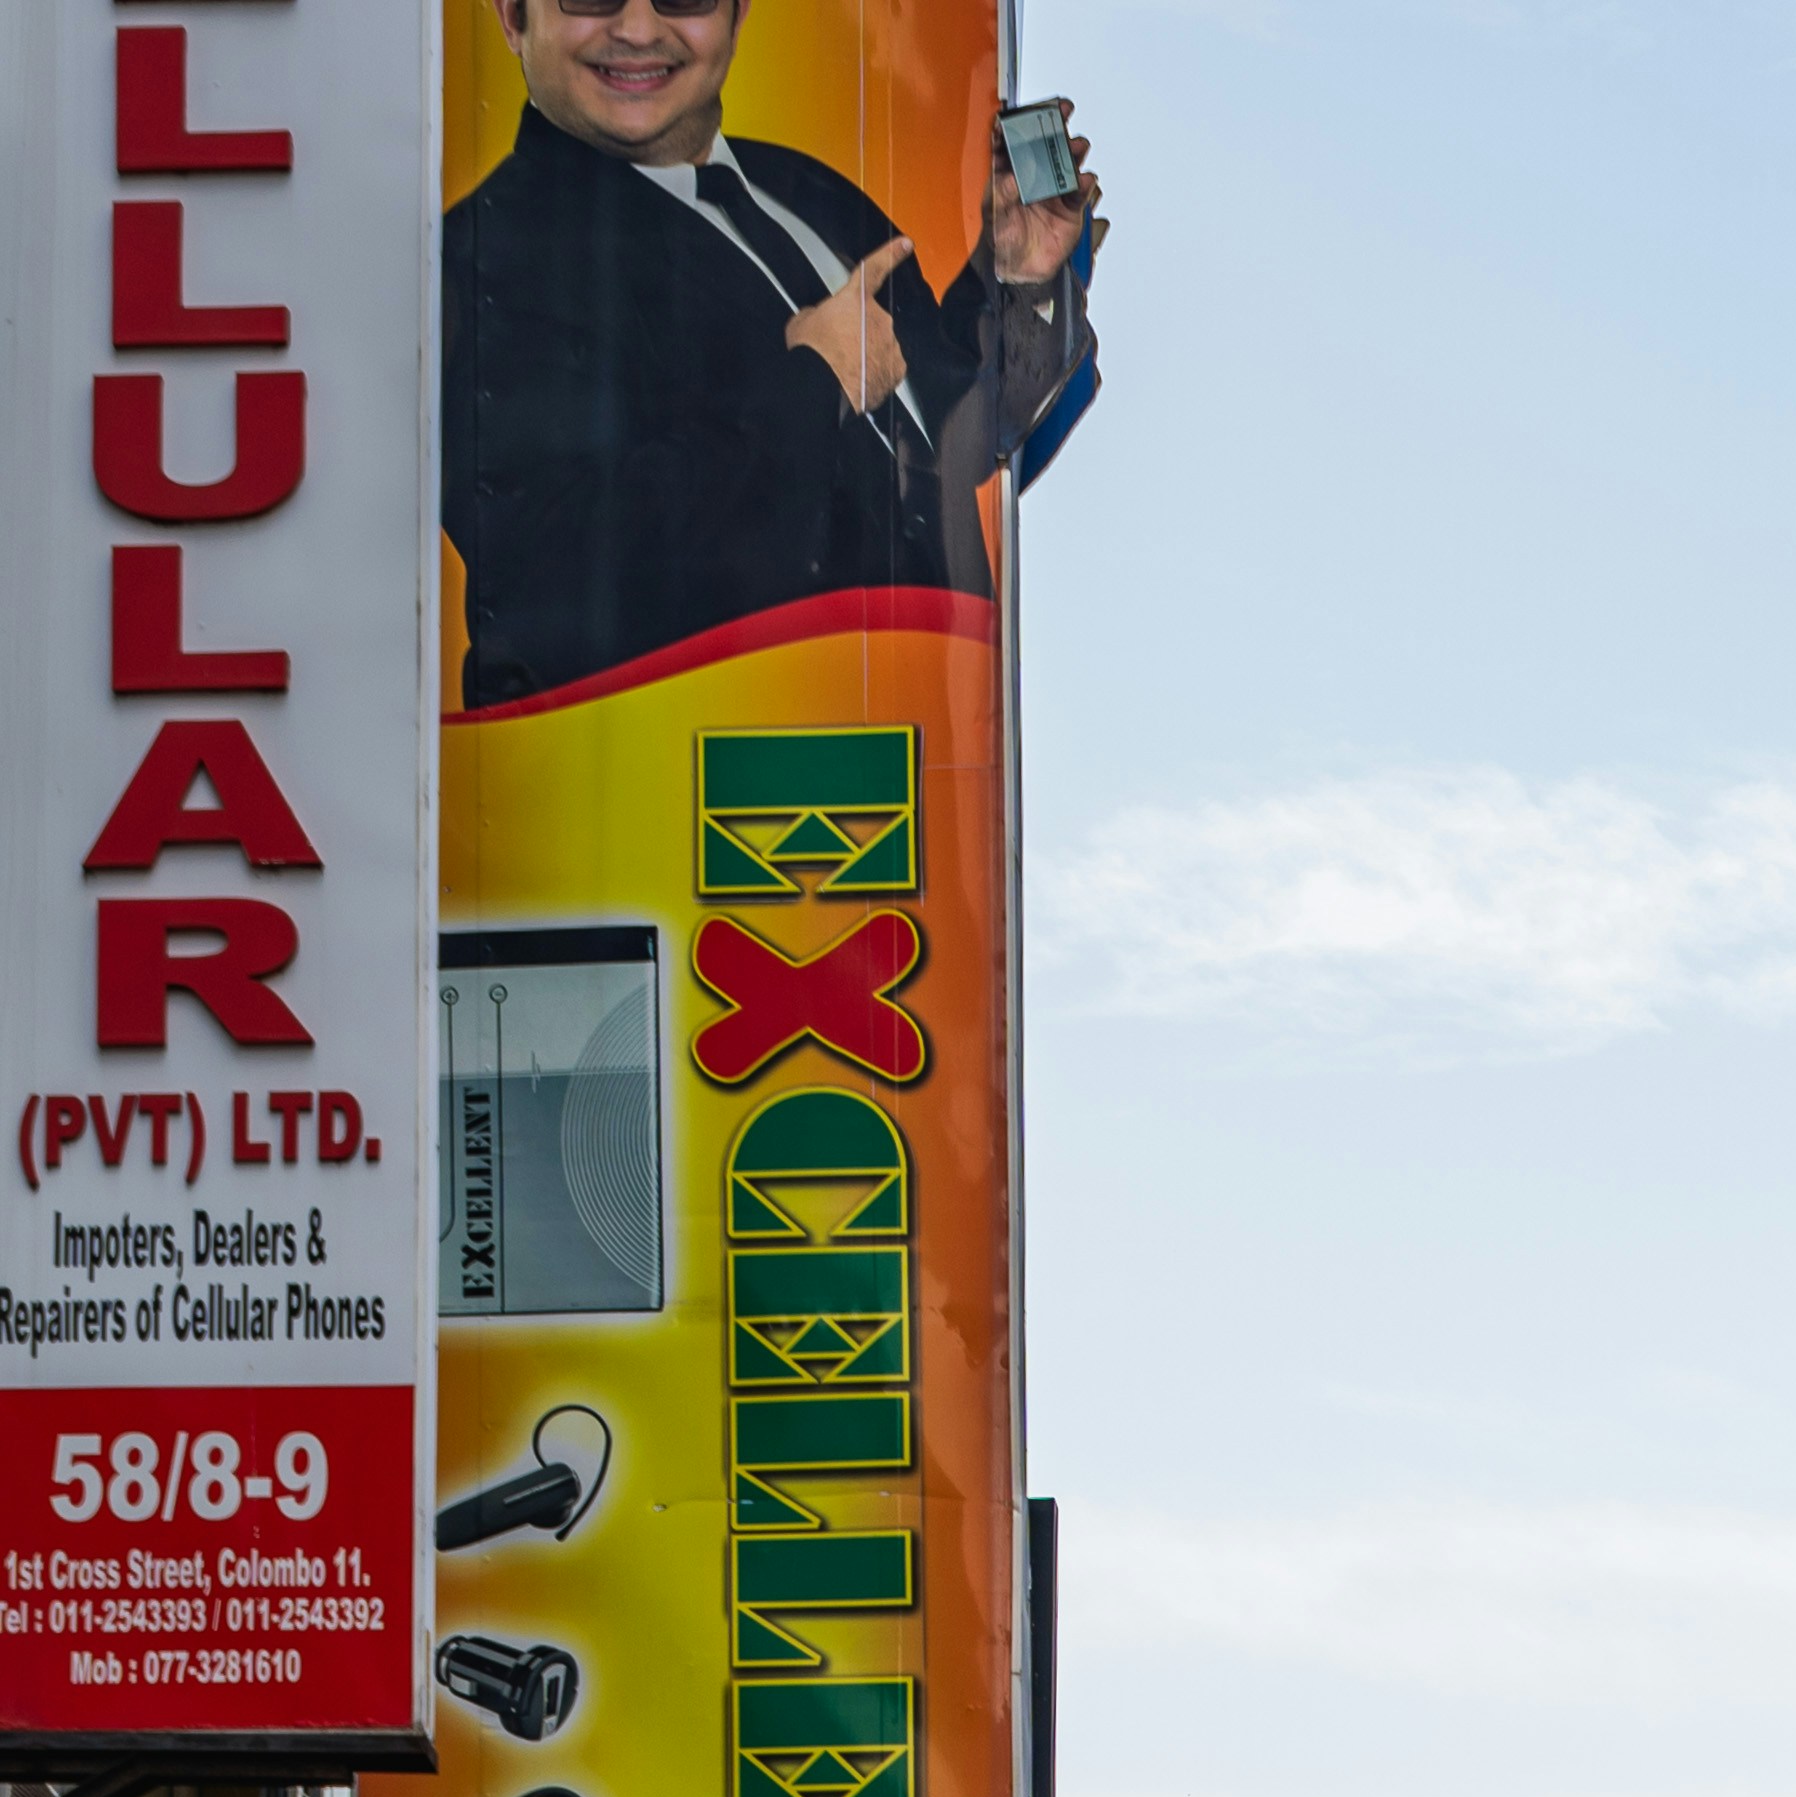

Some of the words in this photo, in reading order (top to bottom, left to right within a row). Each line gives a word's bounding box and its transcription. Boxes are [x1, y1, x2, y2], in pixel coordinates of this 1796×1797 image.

[83, 0, 323, 1048] LLULAR
[19, 1090, 207, 1191] (PVT)
[233, 1090, 381, 1163] LTD.
[461, 1086, 495, 1300] EXCELLENT
[54, 1210, 183, 1282] Impoters,
[193, 1208, 297, 1267] Dealers
[308, 1207, 326, 1265] &
[0, 1286, 126, 1357] Repairers
[136, 1284, 162, 1341] of
[172, 1282, 277, 1341] Cellular
[286, 1283, 386, 1340] Phones
[50, 1430, 329, 1523] 58/8-9
[5, 1551, 43, 1590] 1st
[49, 1550, 120, 1589] Cross
[126, 1549, 212, 1595] Street,
[218, 1548, 325, 1588] Colombo
[333, 1547, 371, 1586] 11.
[48, 1600, 207, 1634] 011-2543393
[227, 1598, 384, 1631] 011-2543392
[70, 1651, 122, 1684] Mob
[144, 1649, 301, 1683] 077-3281610
